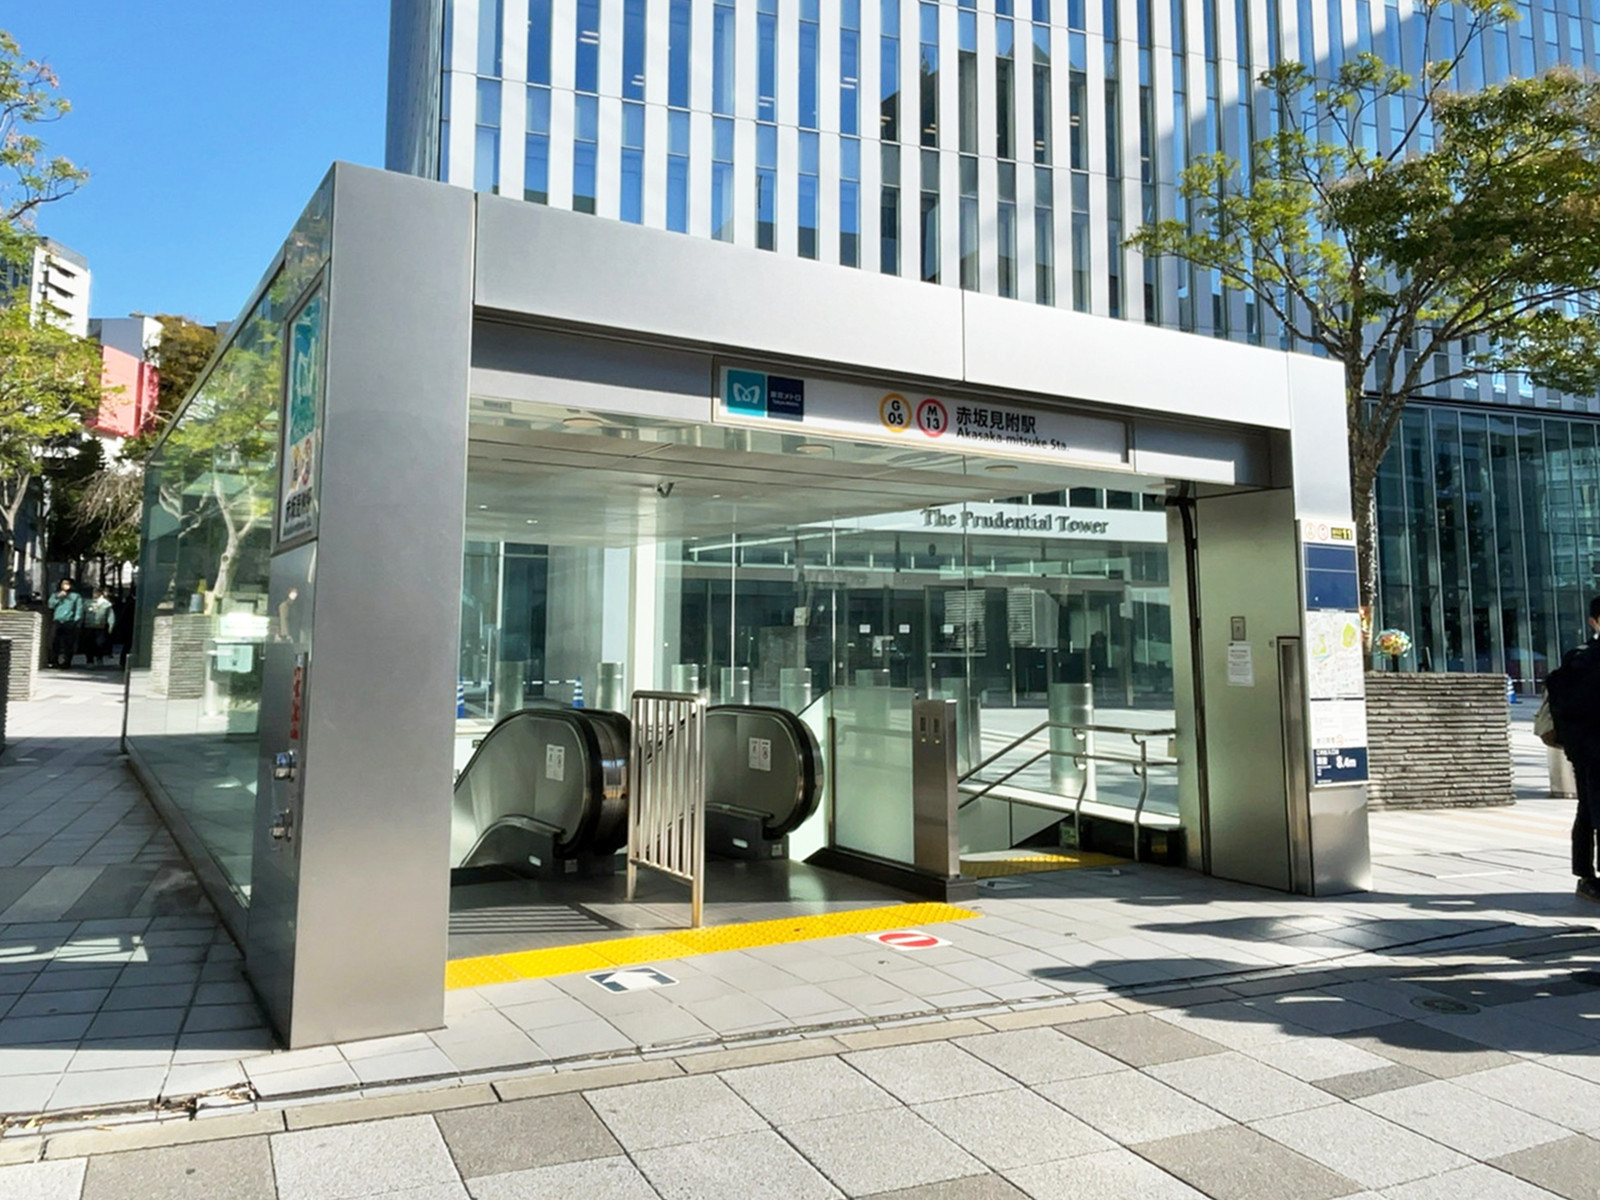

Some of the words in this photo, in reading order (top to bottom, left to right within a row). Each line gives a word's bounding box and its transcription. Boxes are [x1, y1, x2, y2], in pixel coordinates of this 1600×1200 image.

[891, 400, 901, 411] G
[926, 405, 938, 417] M
[888, 412, 904, 425] 05
[926, 417, 940, 430] 13
[956, 406, 1036, 434] 赤坂見附駅
[920, 508, 957, 528] The
[960, 509, 1053, 532] Prudential
[1055, 515, 1109, 534] Tower
